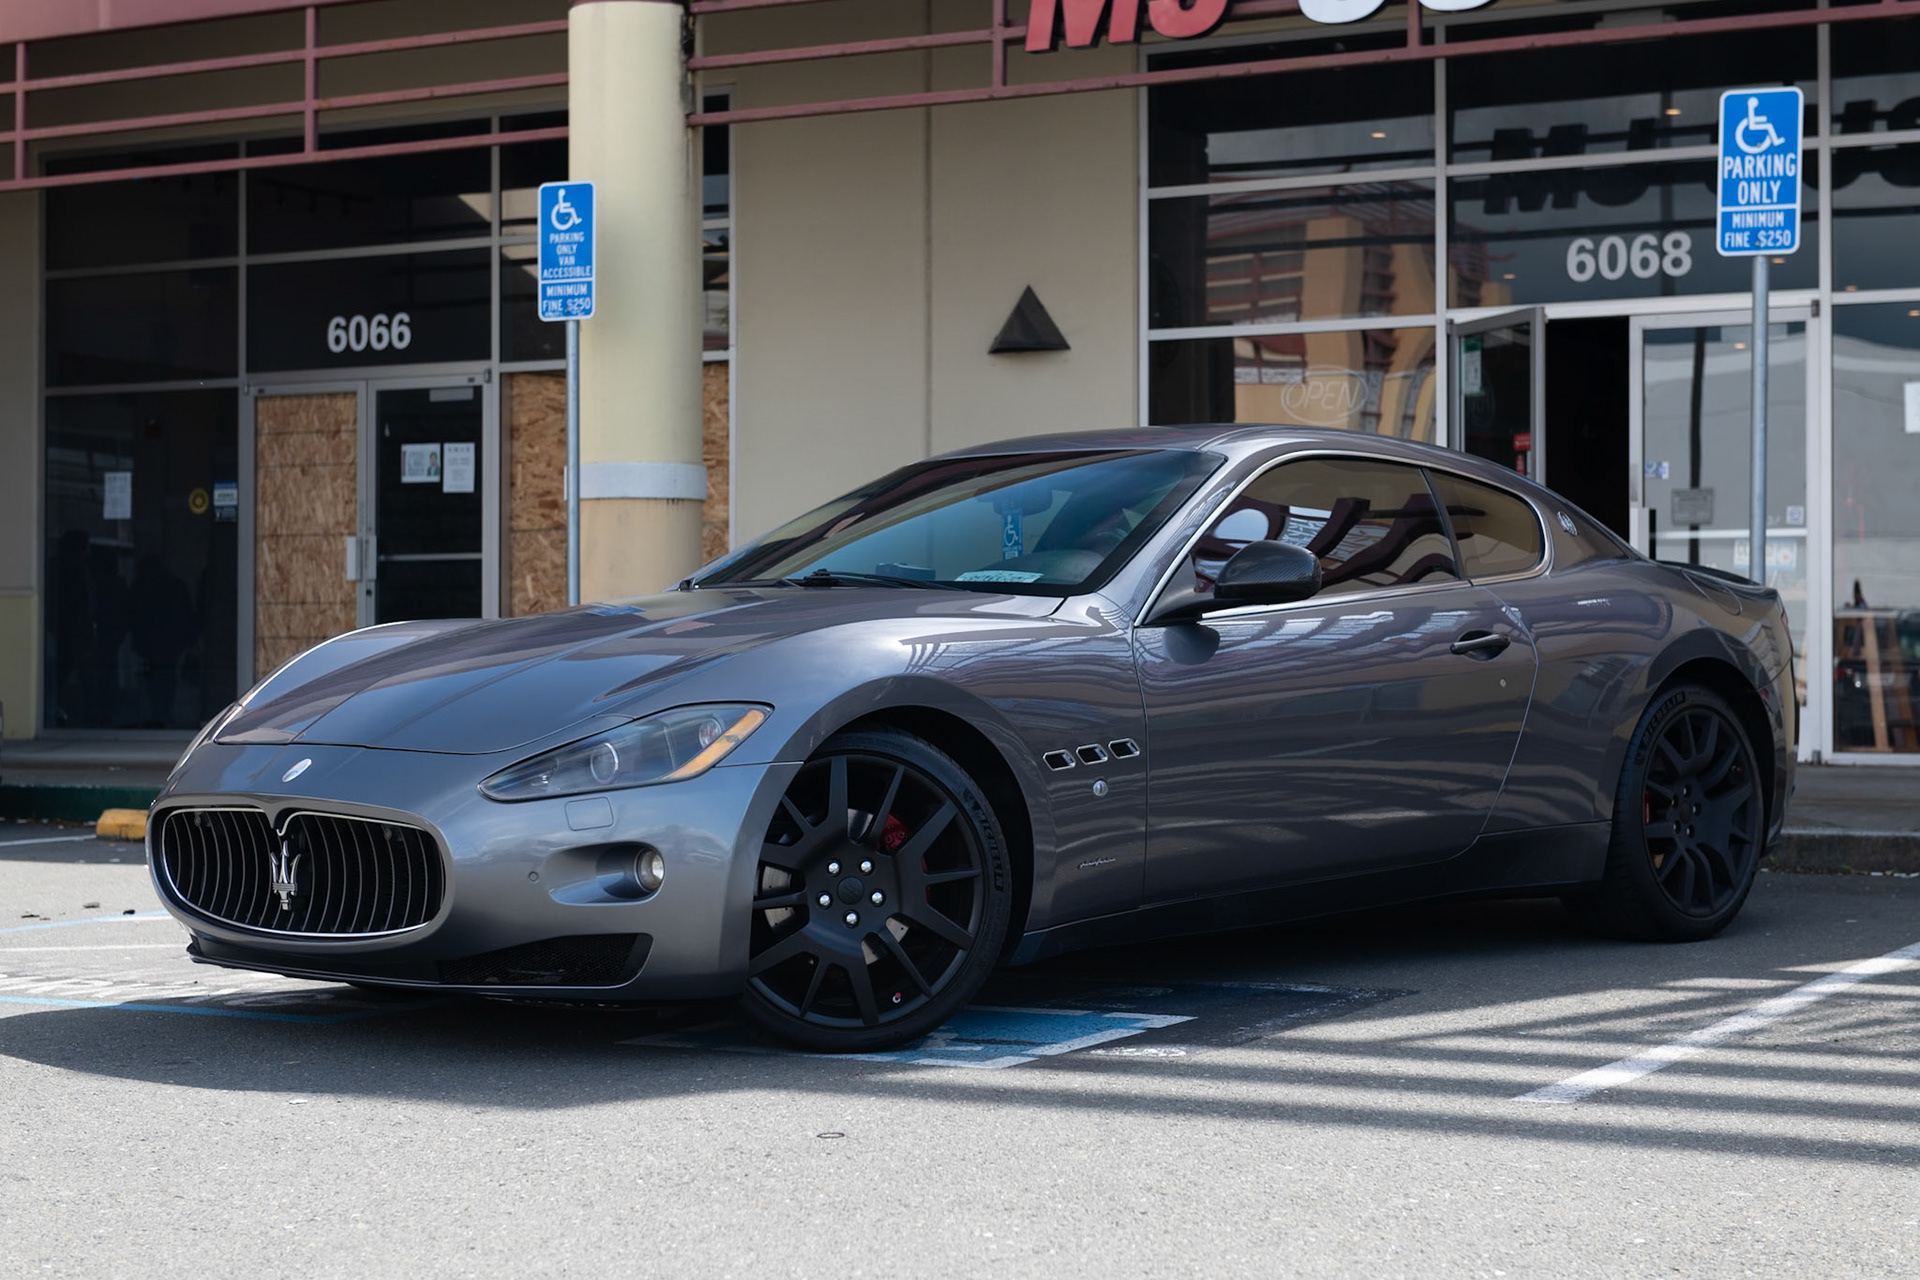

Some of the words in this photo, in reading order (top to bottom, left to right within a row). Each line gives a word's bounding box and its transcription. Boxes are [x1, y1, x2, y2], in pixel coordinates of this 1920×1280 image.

[1723, 153, 1796, 179] PARKING
[1737, 180, 1781, 205] ONLY
[1732, 211, 1784, 229] MINIMUM
[549, 232, 584, 244] PARKING
[1724, 231, 1750, 248] FINE
[1757, 229, 1791, 248] $250
[556, 244, 577, 255] ONLY
[1566, 231, 1692, 282] 6068
[559, 255, 575, 266] VAN
[543, 265, 591, 279] ACCESSIBLE
[546, 283, 587, 297] MINIMUM
[543, 299, 563, 312] FINE
[566, 297, 591, 312] $250
[327, 312, 411, 353] 6066
[1286, 380, 1361, 410] OPEN
